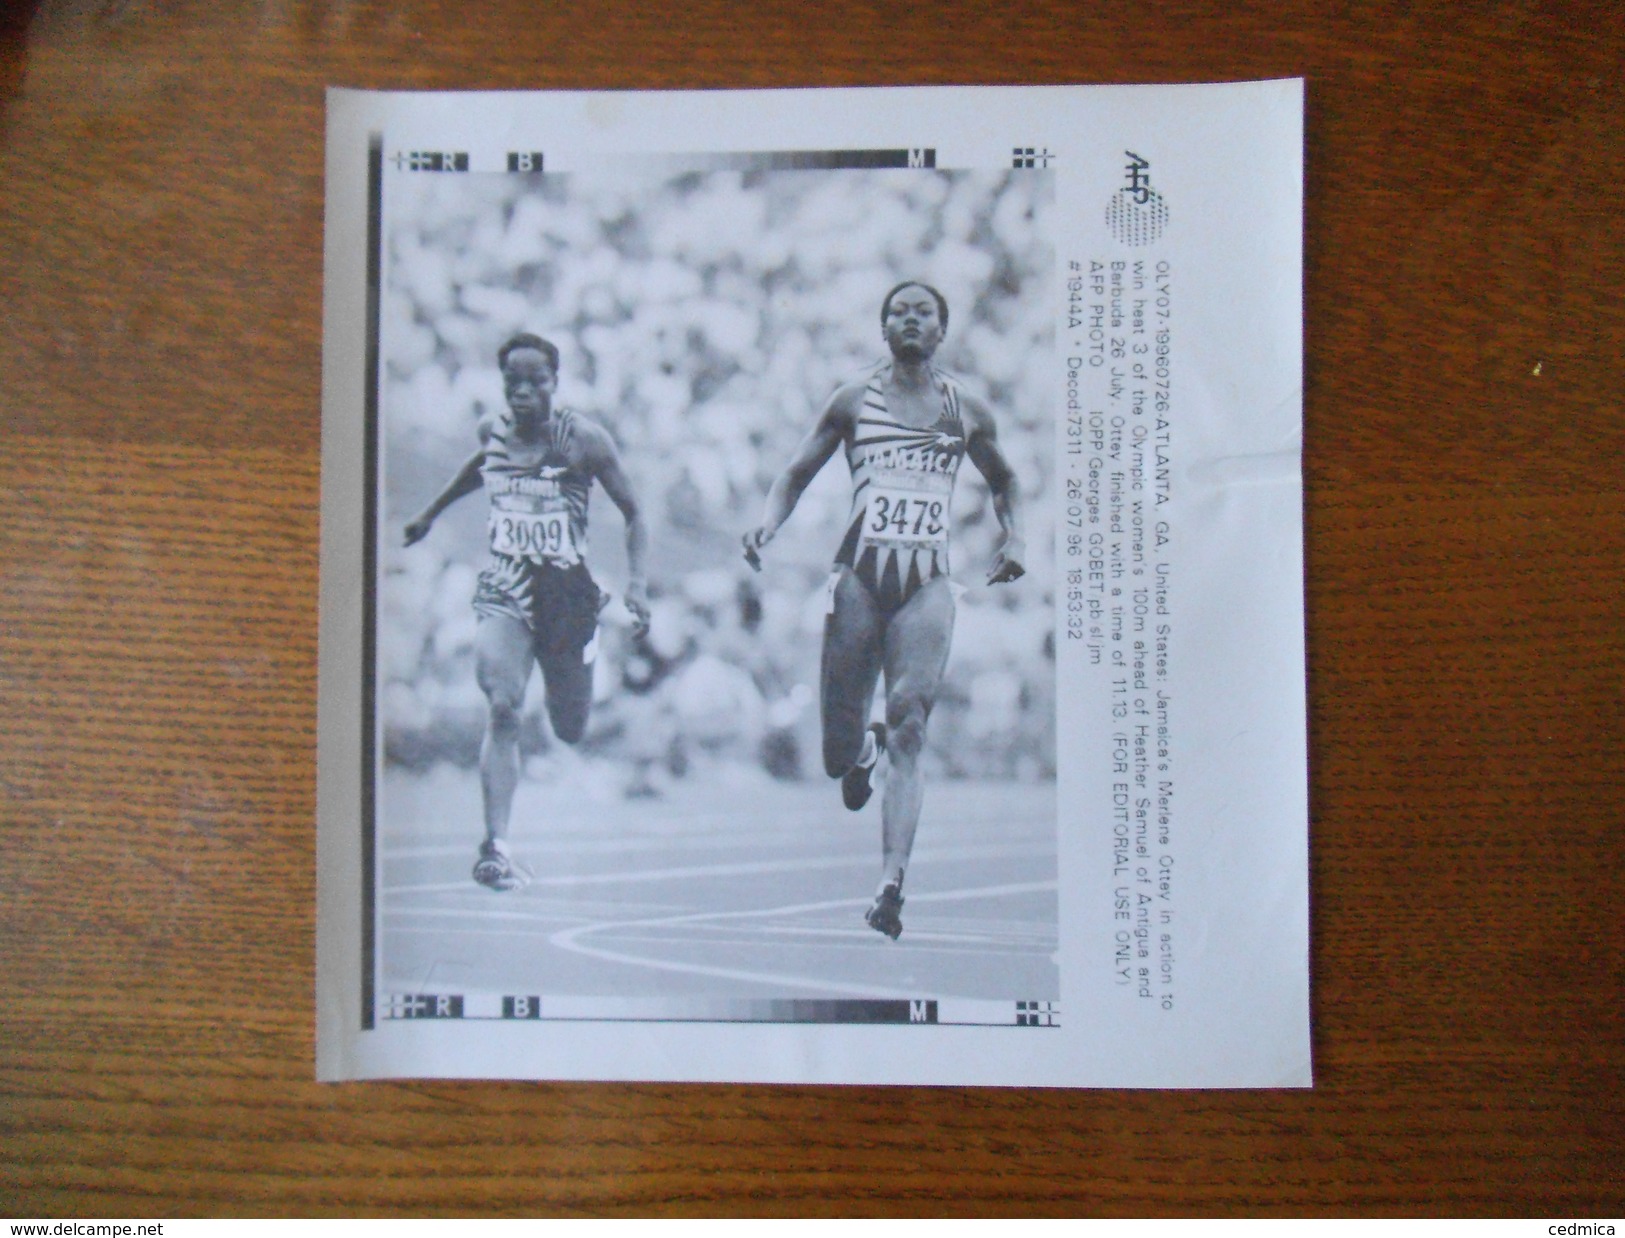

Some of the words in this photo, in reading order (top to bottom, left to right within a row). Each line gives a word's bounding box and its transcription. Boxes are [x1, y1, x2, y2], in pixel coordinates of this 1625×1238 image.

[907, 148, 924, 169] M
[1124, 150, 1150, 205] AFP
[1068, 260, 1082, 328] #1944A
[1089, 260, 1104, 295] AFP
[1110, 261, 1125, 328] Barbuda
[1132, 261, 1147, 289] win
[1089, 305, 1104, 368] PHOTO
[1132, 300, 1147, 334] heat
[1110, 338, 1125, 358] 26
[1132, 344, 1148, 354] 3
[1108, 367, 1125, 406] July.
[1132, 364, 1148, 380] of
[1068, 357, 1082, 454] Decod:7311
[1133, 390, 1148, 416] the
[1108, 416, 1125, 460] Ottey
[1129, 426, 1148, 490] Olympic
[864, 447, 958, 475] JAMAICA
[871, 495, 944, 535] 3478
[1110, 472, 1125, 534] finished
[502, 518, 562, 552] 3009
[1132, 501, 1147, 576] women's
[1110, 542, 1125, 578] with
[1068, 570, 1083, 640] 18:53:32
[1111, 588, 1122, 596] a
[1133, 587, 1148, 632] 100m
[1156, 564, 1170, 615] United
[1112, 606, 1126, 640] time
[1112, 650, 1126, 667] of
[1134, 641, 1149, 689] ahead
[1156, 625, 1170, 682] States:
[1134, 698, 1149, 715] of
[1157, 690, 1172, 771] Jamaica's
[1112, 732, 1128, 774] (FOR
[1134, 726, 1150, 788] Heather
[1112, 784, 1129, 876] EDITORIAL
[1135, 798, 1151, 858] Samuel
[1158, 781, 1173, 844] Merlene
[1136, 867, 1152, 884] of
[1156, 856, 1174, 900] Ottey
[1114, 888, 1130, 920] USE
[1160, 910, 1174, 924] in
[1134, 894, 1152, 958] Antigua
[1114, 931, 1130, 986] ONLY)
[1160, 934, 1174, 984] action
[1138, 968, 1154, 998] and
[1161, 994, 1174, 1010] to
[514, 996, 530, 1018] B
[909, 999, 927, 1022] M
